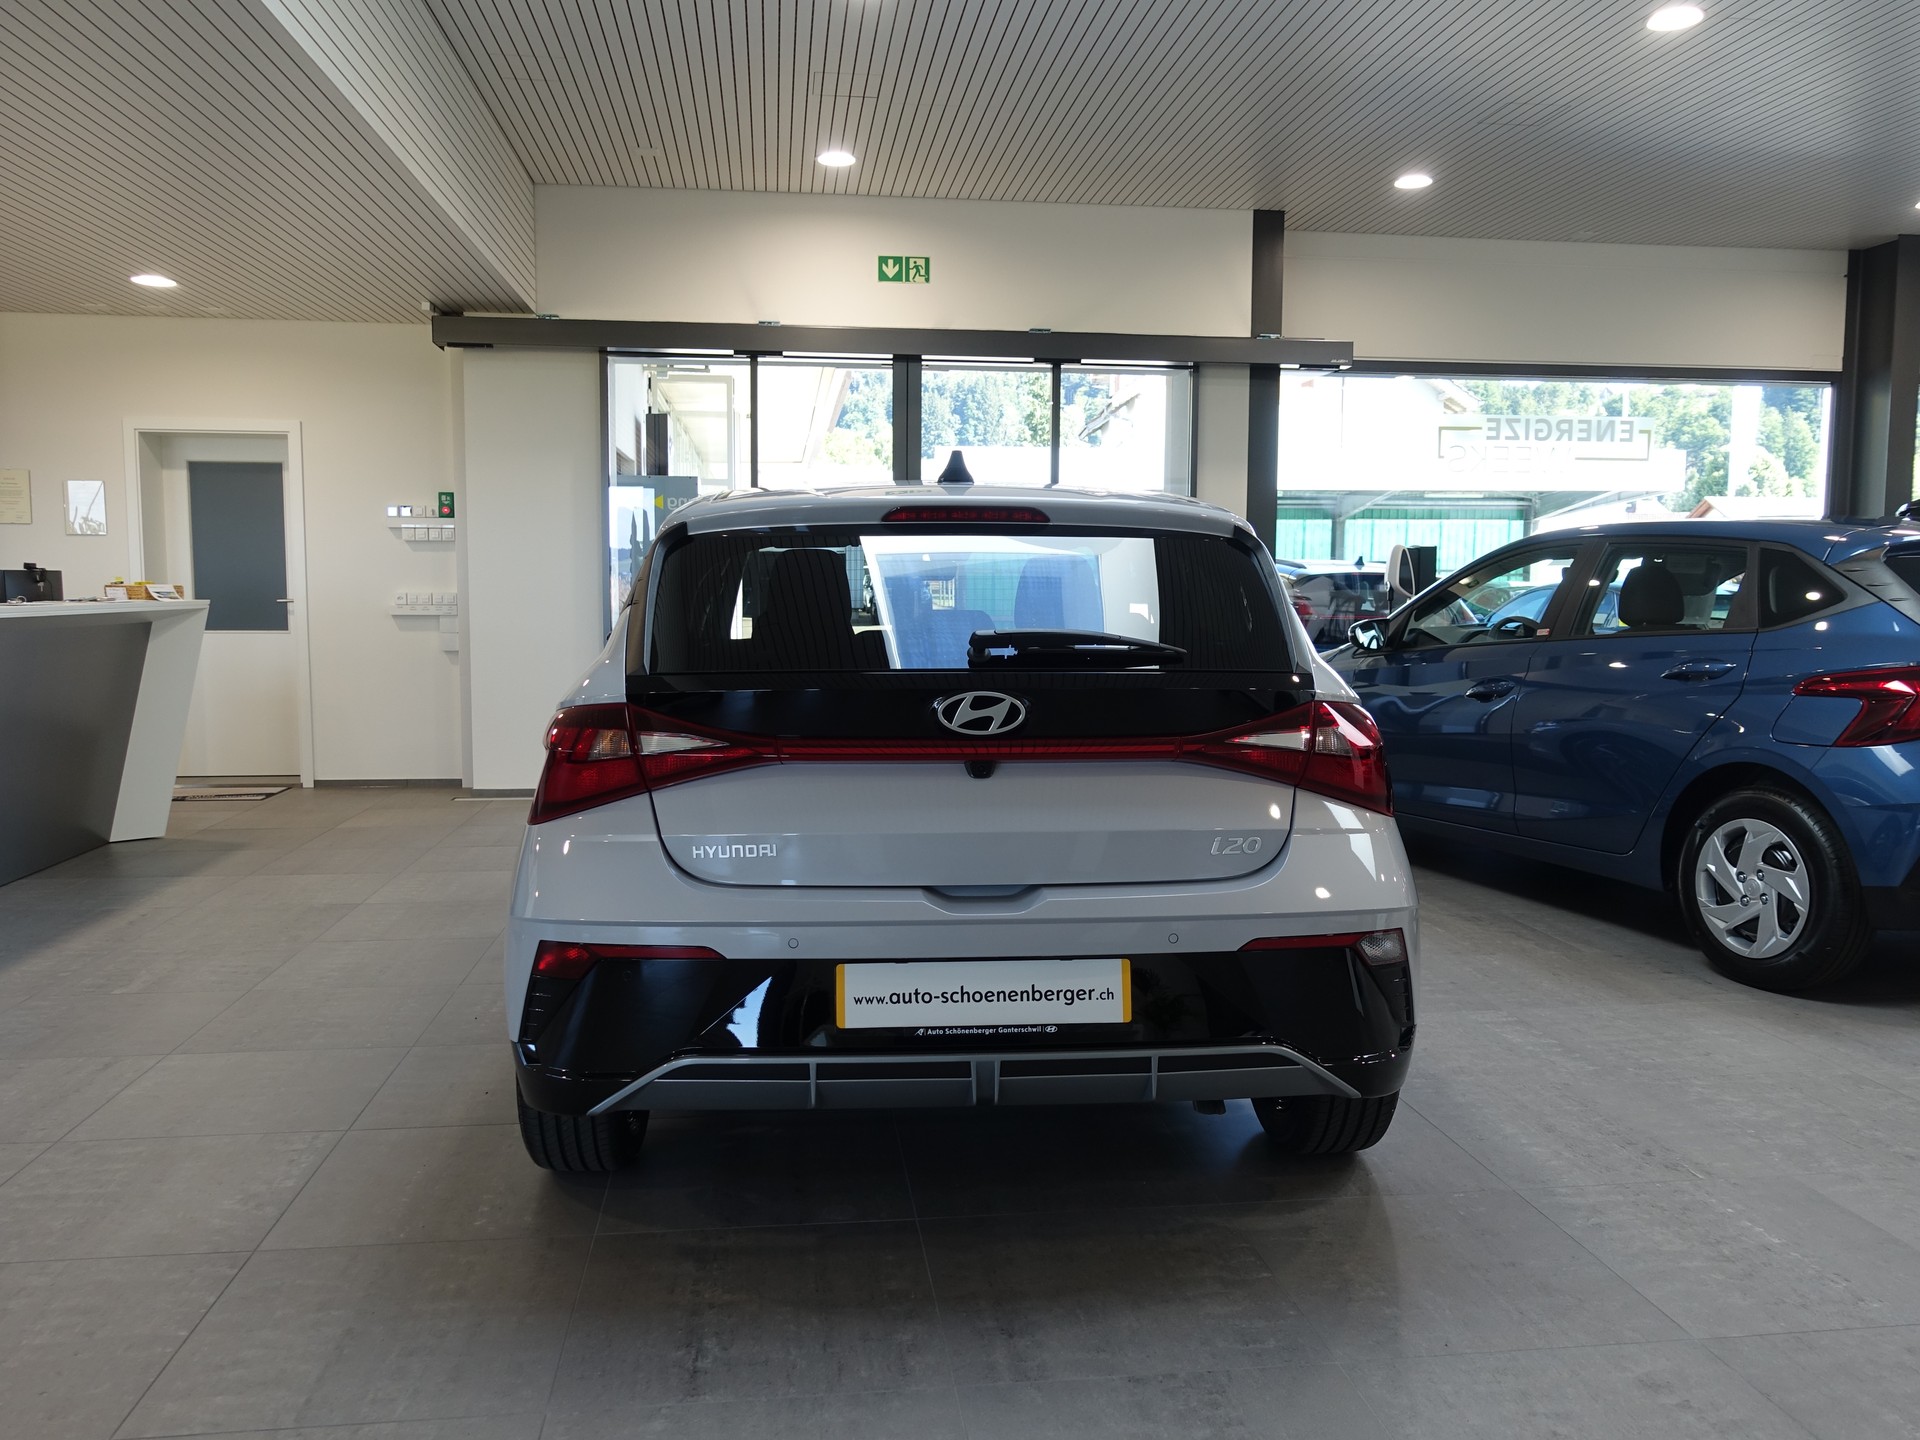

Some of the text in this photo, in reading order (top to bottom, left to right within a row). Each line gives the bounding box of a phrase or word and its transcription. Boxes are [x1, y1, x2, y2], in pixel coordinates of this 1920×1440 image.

[692, 843, 777, 859] HYUNDAI
[853, 983, 1115, 1006] www.auto-schoenenberger.ch
[927, 1027, 944, 1036] Auto
[945, 1026, 997, 1036] Schönenberger
